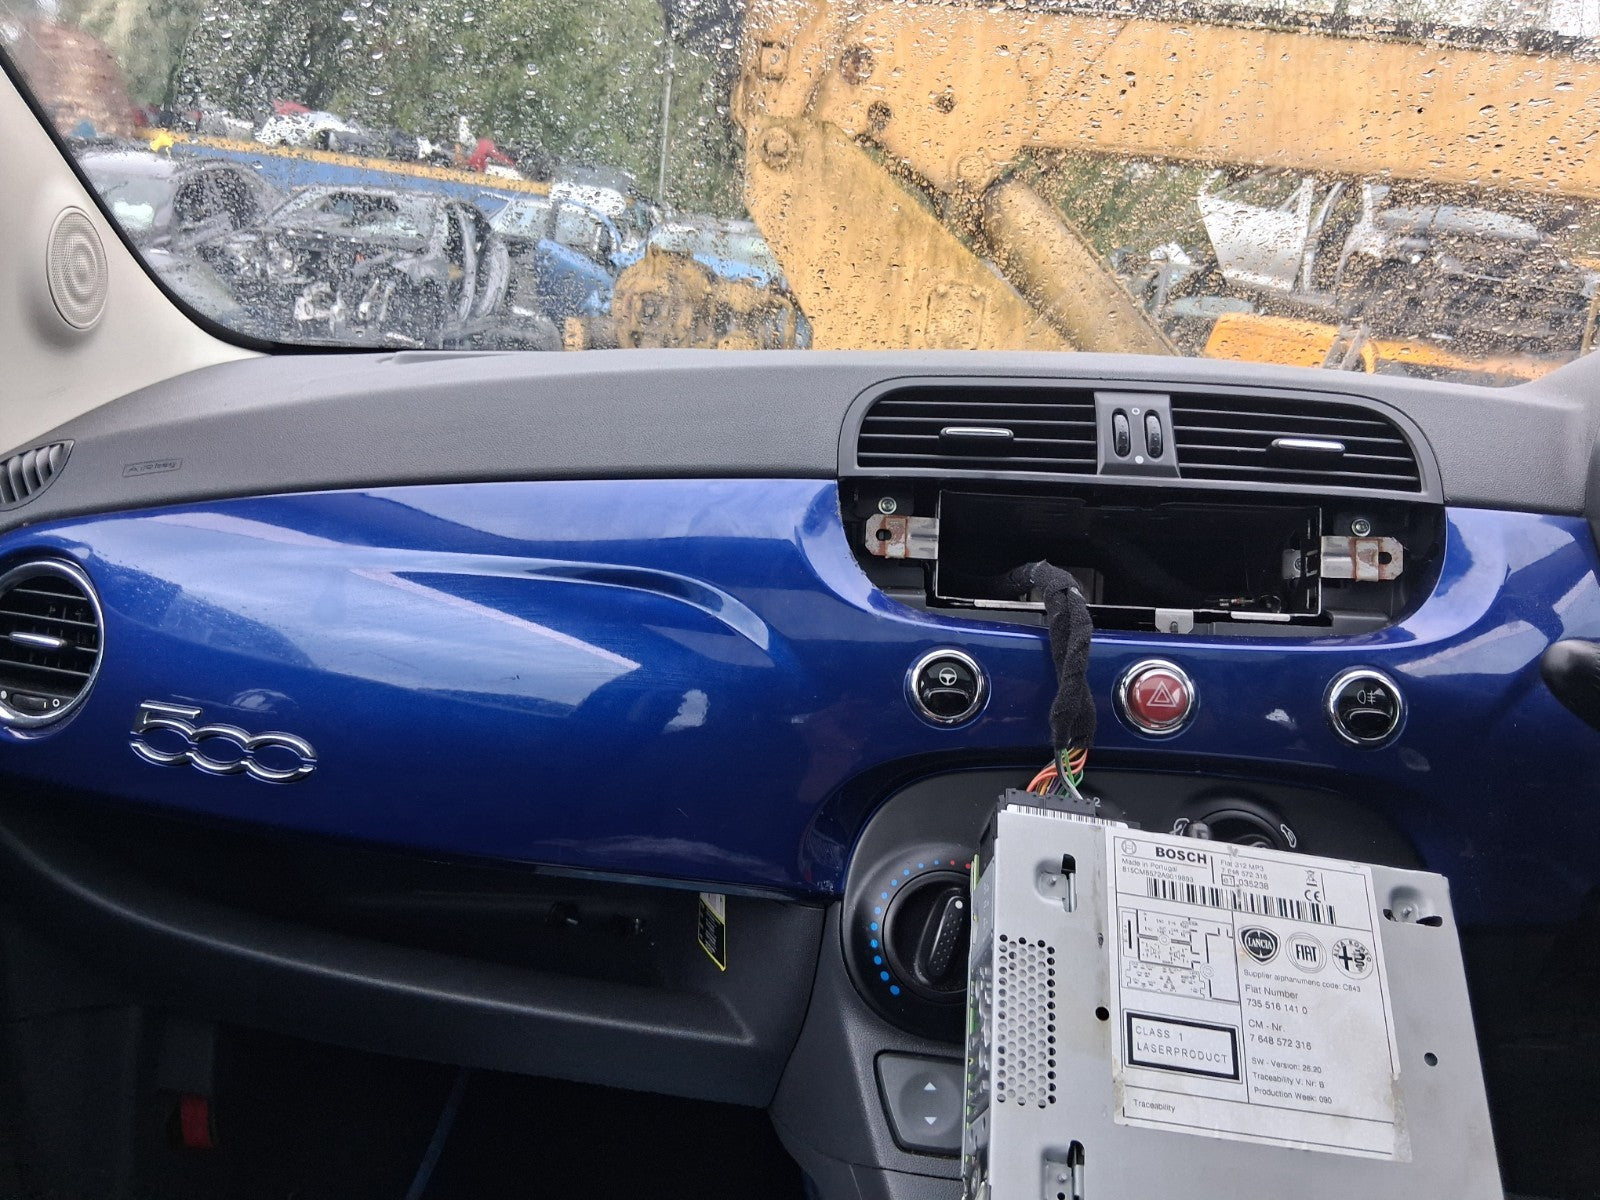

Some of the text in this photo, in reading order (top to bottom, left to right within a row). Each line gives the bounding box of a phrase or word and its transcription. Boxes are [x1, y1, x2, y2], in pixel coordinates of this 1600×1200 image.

[129, 699, 318, 785] 500
[1155, 846, 1207, 864] BOSCH
[1122, 858, 1140, 867] Made
[1150, 862, 1177, 872] Portugal
[1248, 937, 1272, 950] LANCIA
[1295, 944, 1317, 962] FIAT
[1243, 969, 1272, 980] Supplier
[1274, 974, 1320, 987] alphanumeric
[1322, 981, 1341, 990] code:
[1245, 984, 1298, 1000] Fiat Number
[1247, 998, 1308, 1015] 735 516 141 0
[1136, 1026, 1170, 1039] CLASS
[1249, 1019, 1263, 1029] CM
[1272, 1022, 1285, 1032] Nr.
[1250, 1034, 1312, 1051] 7 648 572 316
[1137, 1041, 1228, 1064] LASERPRODUCT
[1251, 1057, 1264, 1066] SW
[1270, 1060, 1300, 1070] Version:
[1252, 1071, 1293, 1085] Traceability
[1254, 1086, 1293, 1099] Production
[1295, 1091, 1317, 1102] Week:
[1133, 1099, 1176, 1113] Traceability
